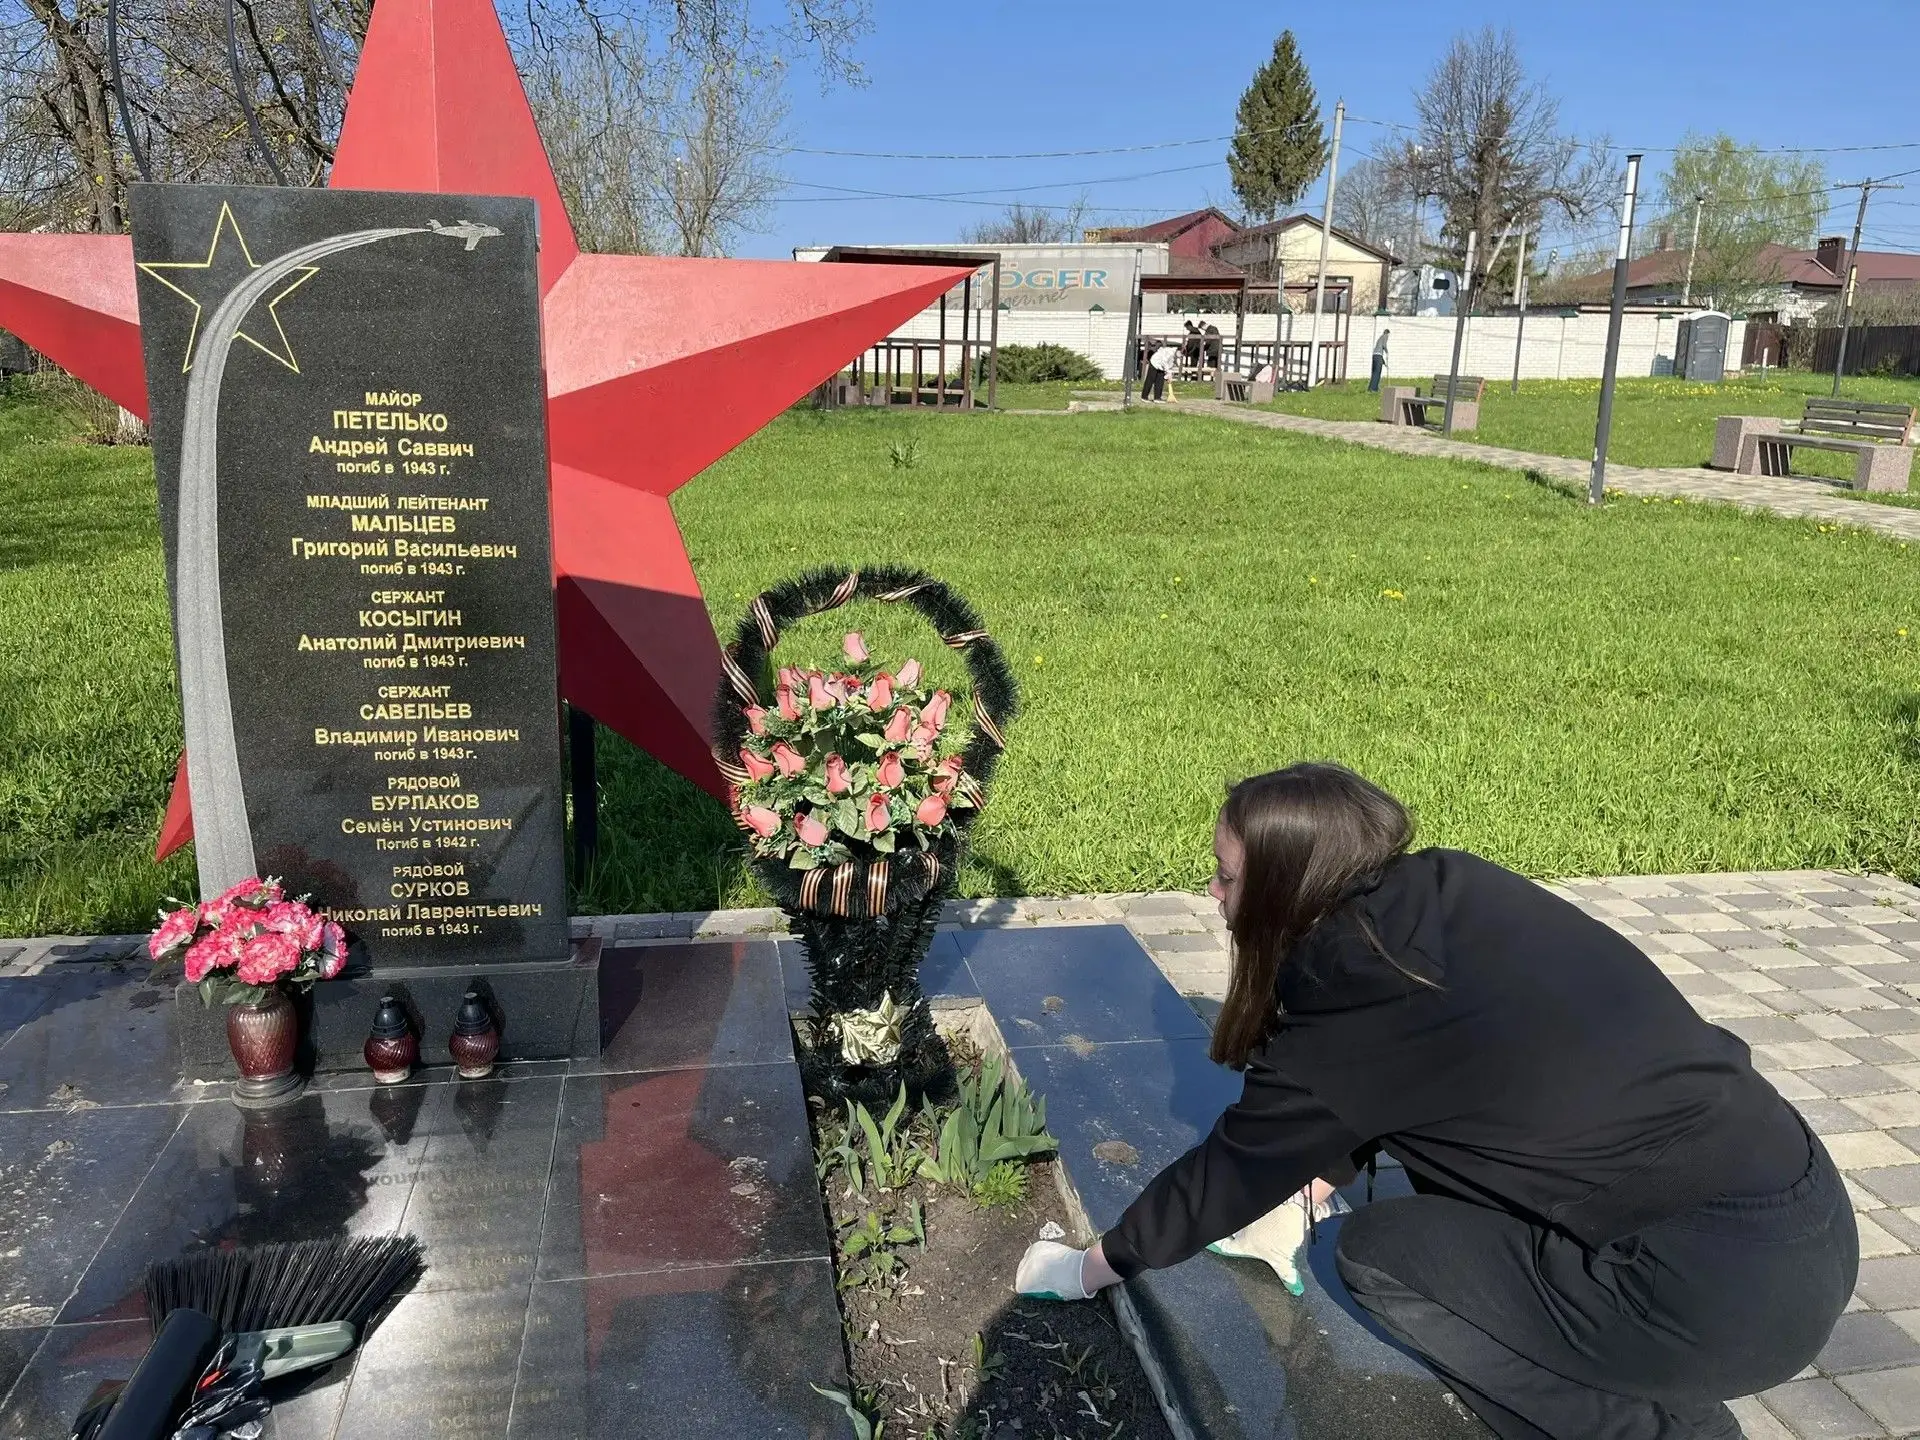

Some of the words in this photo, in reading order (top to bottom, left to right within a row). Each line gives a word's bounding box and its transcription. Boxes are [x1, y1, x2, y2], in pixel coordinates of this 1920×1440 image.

[366, 390, 422, 406] МАЙОР
[333, 411, 448, 432] ПЕТЕЛЬКО
[309, 436, 388, 457] Андрей
[398, 439, 474, 457] Саввич
[337, 462, 380, 474] погиб
[385, 463, 394, 474] в
[403, 462, 436, 474] 1943
[440, 463, 450, 475] г.
[307, 494, 389, 509] МЛАДШИЙ
[397, 494, 489, 510] ЛЕЙТЕНАНТ
[351, 515, 456, 535] МАЛЬЦЕВ
[291, 538, 389, 558] Григорий
[394, 539, 517, 558] Васильевич
[360, 563, 403, 575] погиб
[408, 564, 416, 575] в
[421, 564, 454, 575] 1943
[456, 565, 466, 575] г.
[371, 590, 445, 603] СЕРЖАНТ
[359, 610, 462, 628] КОСЫГИН
[298, 635, 397, 652] Анатолий
[402, 635, 525, 653] Дмитриевич
[363, 656, 406, 669] погиб
[410, 657, 418, 668] в
[422, 656, 455, 668] 1943
[459, 658, 468, 667] г.
[378, 685, 451, 698] СЕРЖАНТ
[360, 703, 473, 720] САВЕЛЬЕВ
[314, 727, 418, 745] Владимир
[423, 727, 520, 742] Иванович
[374, 749, 416, 761] погиб
[420, 750, 429, 760] в
[432, 748, 464, 759] 1943
[465, 750, 477, 760] г.
[388, 773, 460, 791] РЯДОВОЙ
[371, 794, 480, 811] БУРЛАКОВ
[341, 818, 404, 834] Семён
[408, 816, 512, 833] Устинович
[376, 837, 419, 851] Погиб
[422, 839, 431, 849] в
[435, 836, 467, 848] 1942
[469, 839, 480, 848] г.
[392, 861, 464, 878] РЯДОВОЙ
[391, 881, 469, 898] СУРКОВ
[318, 903, 401, 922] Николай
[406, 902, 542, 921] Лаврентьевич
[382, 925, 423, 938] погиб
[426, 927, 435, 936] в
[438, 923, 469, 936] 1943
[472, 925, 482, 935] г.
